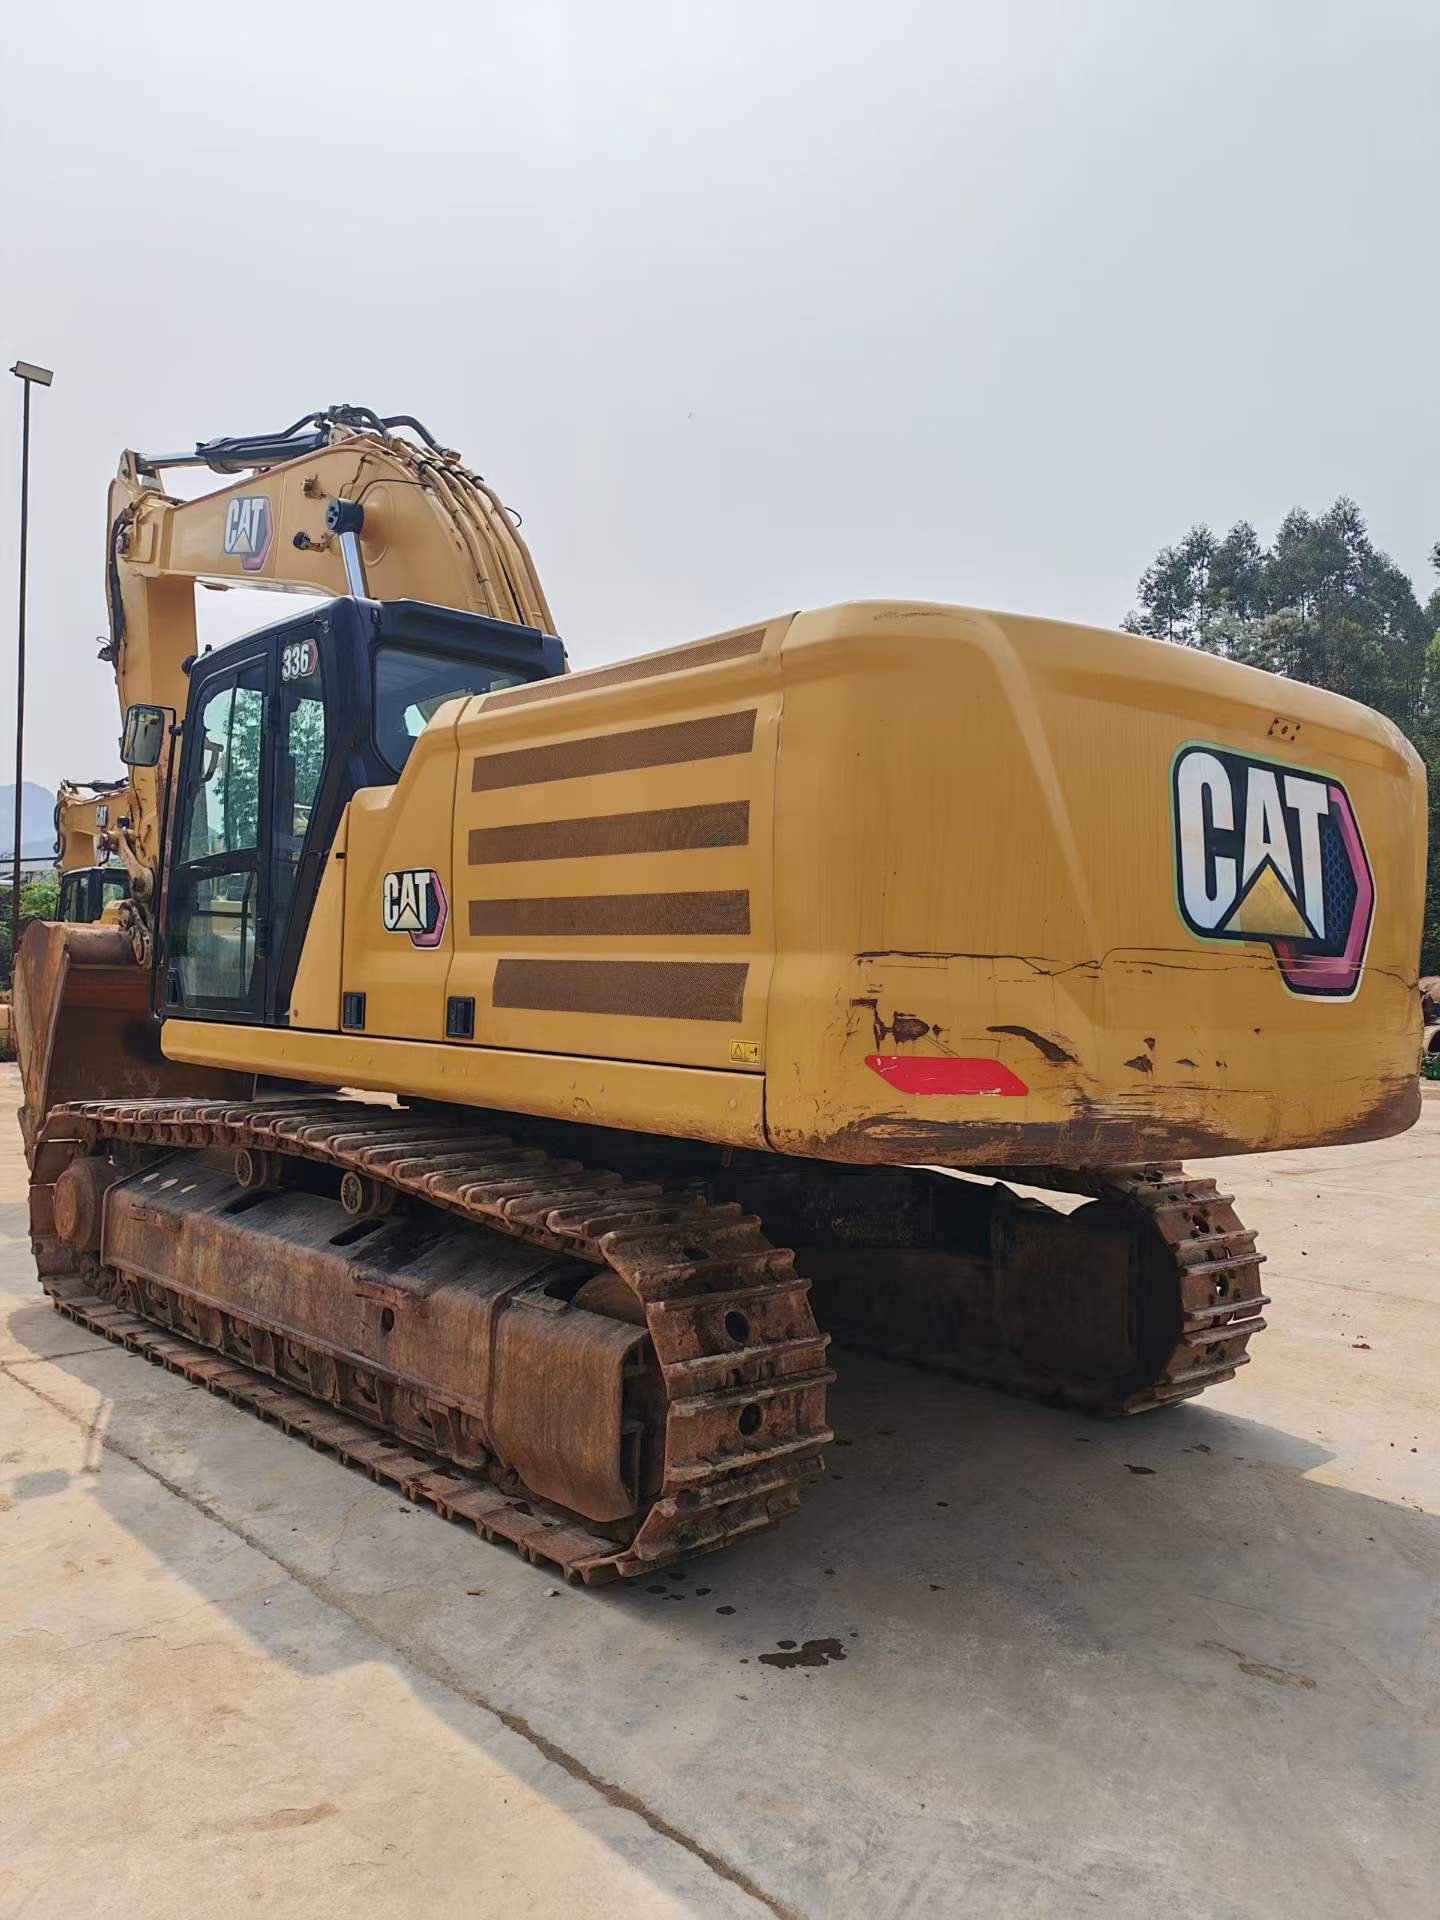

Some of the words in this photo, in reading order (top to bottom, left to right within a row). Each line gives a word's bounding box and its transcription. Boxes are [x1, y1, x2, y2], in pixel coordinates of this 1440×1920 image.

[225, 499, 265, 552] CAT
[283, 644, 309, 678] 336
[1178, 752, 1328, 940] CAT
[384, 872, 430, 929] CAT
